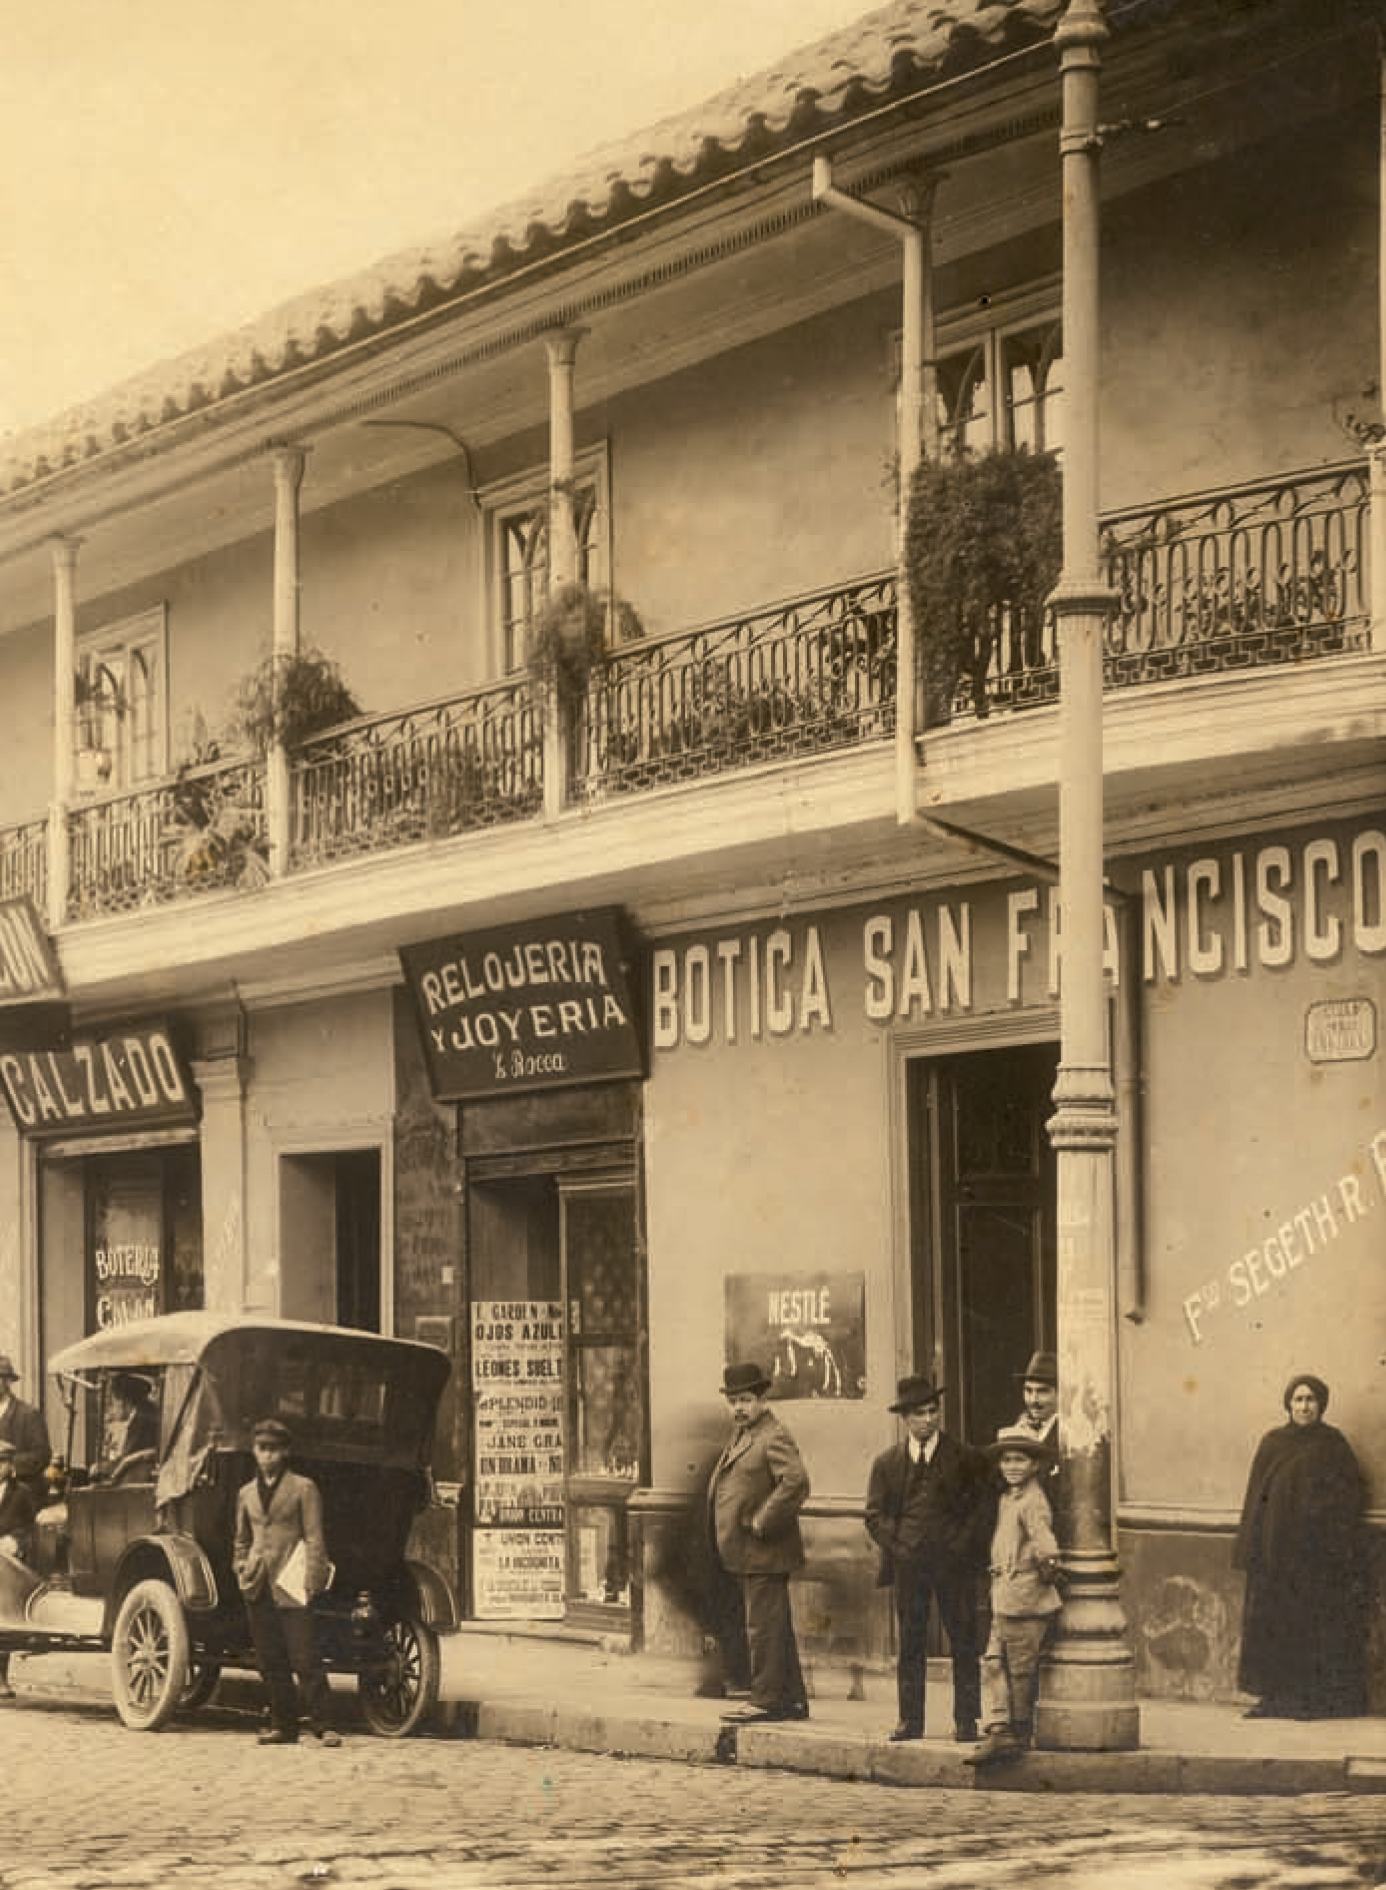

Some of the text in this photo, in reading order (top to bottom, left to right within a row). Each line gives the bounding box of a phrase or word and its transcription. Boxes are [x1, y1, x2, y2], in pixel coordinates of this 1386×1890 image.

[420, 940, 607, 1015] RELOJERIA
[654, 926, 832, 1048] BOTICA
[864, 902, 974, 1020] SAN
[431, 993, 627, 1053] Y JOYERIA
[0, 1032, 185, 1125] CALZADO
[1229, 1195, 1339, 1307] SEGETH
[476, 1324, 513, 1341] OJOS
[476, 1360, 520, 1377] LEONES
